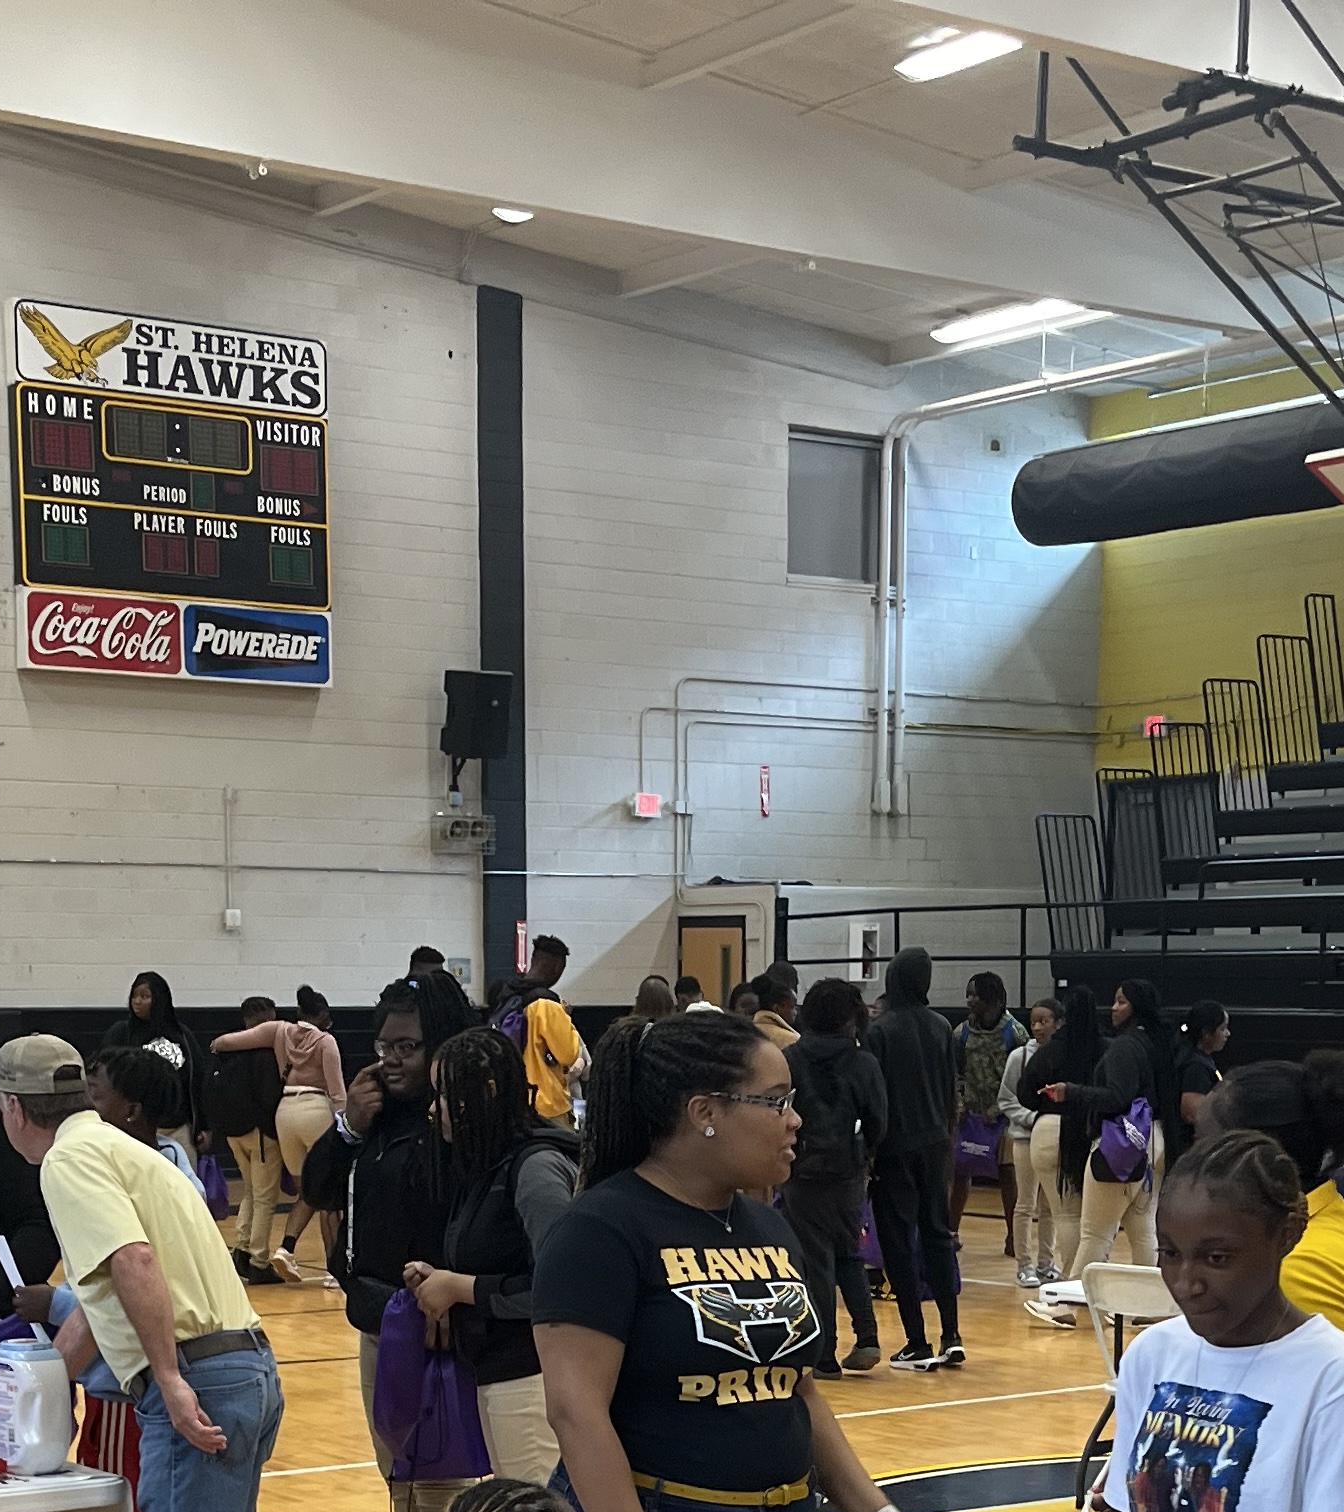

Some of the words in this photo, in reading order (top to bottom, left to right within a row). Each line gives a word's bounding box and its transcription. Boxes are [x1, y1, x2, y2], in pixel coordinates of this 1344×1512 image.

[135, 323, 179, 350] ST.
[191, 331, 319, 369] HELENA
[122, 347, 322, 409] HAWKS
[28, 391, 94, 421] HOME
[256, 419, 322, 447] VISITOR
[52, 474, 101, 497] BONUS
[143, 484, 187, 504] PERIOD
[43, 503, 88, 526] FOULS
[257, 496, 301, 517] BONUS
[133, 512, 186, 535] PLAYER
[195, 518, 238, 540] FOULS
[270, 526, 311, 547] FOULS
[31, 600, 176, 662] Coca-Cola
[660, 1245, 803, 1286] HAWK
[677, 1365, 814, 1406] PRID
[1185, 1395, 1234, 1426] Loving
